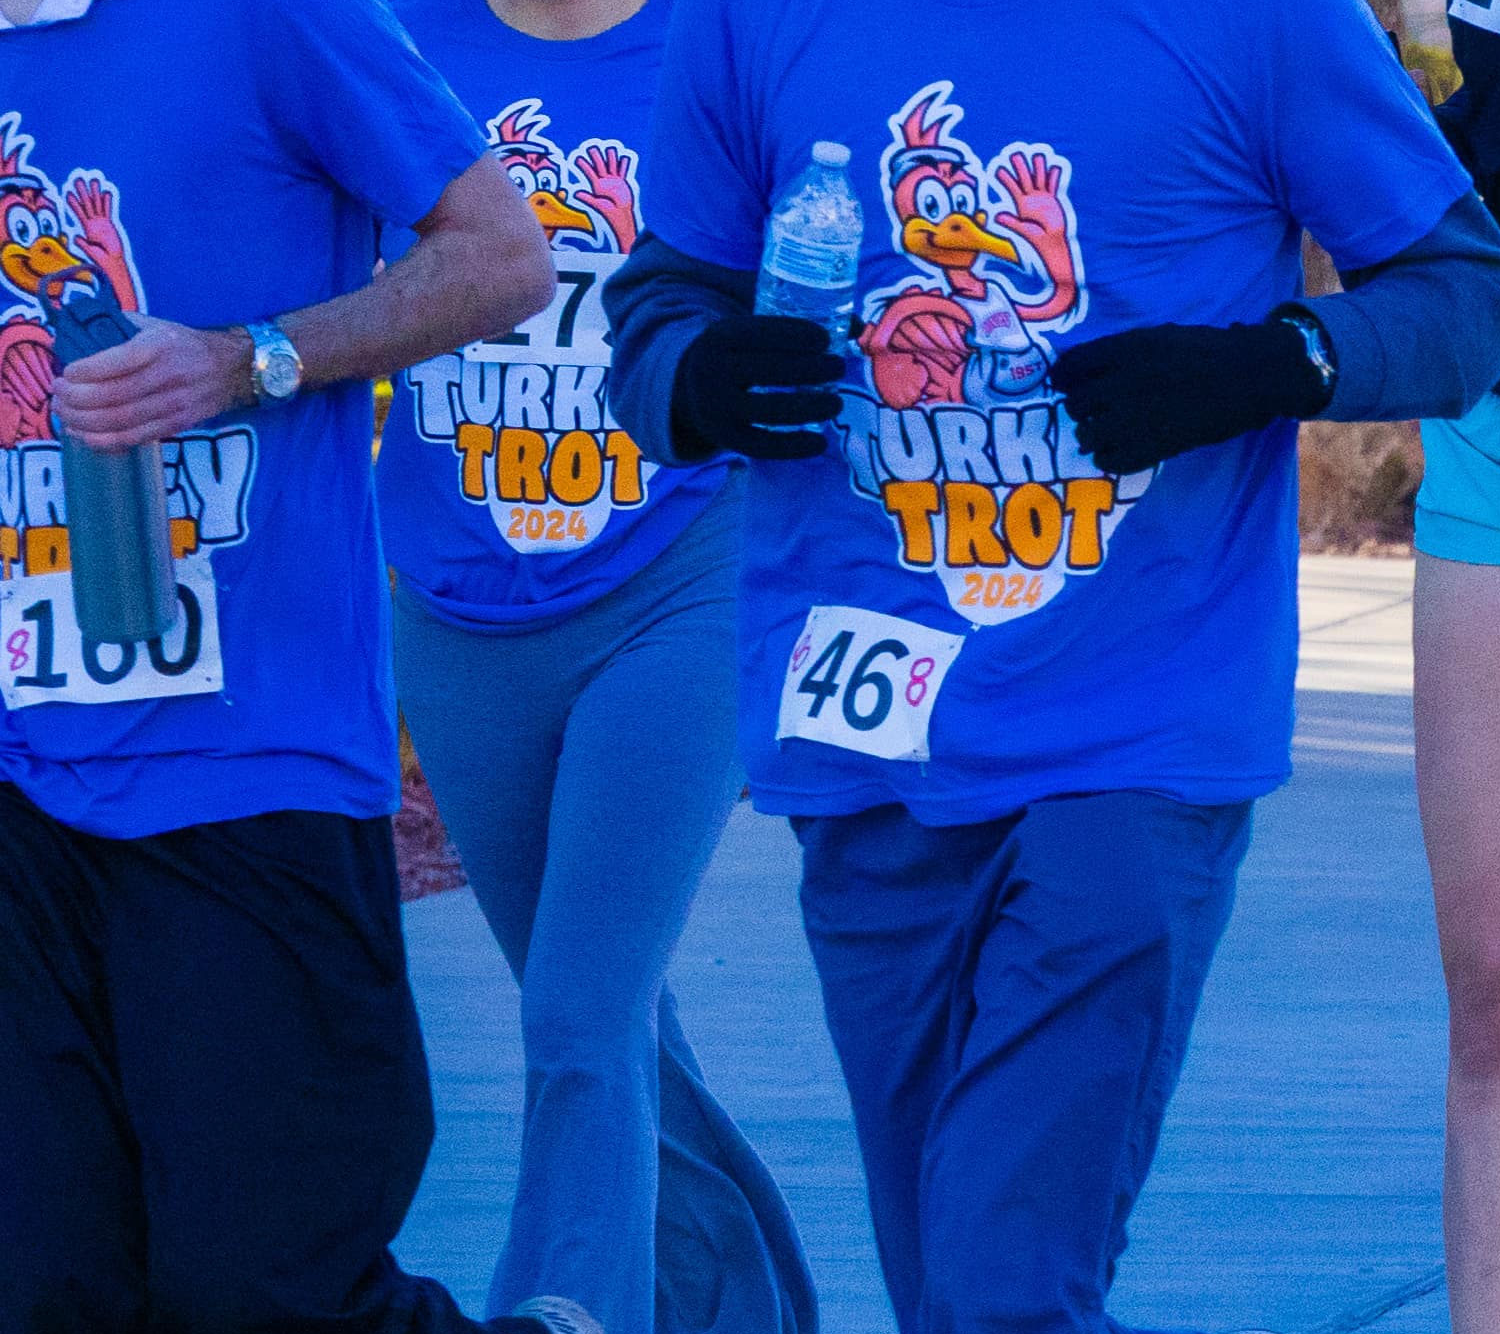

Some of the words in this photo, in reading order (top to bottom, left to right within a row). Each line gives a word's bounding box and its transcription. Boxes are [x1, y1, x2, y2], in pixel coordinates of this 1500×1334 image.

[404, 352, 624, 439] TURK
[456, 423, 645, 505] TROT
[506, 506, 589, 542] 2024
[881, 477, 1115, 570] TROT
[957, 572, 1044, 609] 2024
[796, 629, 911, 733] 46
[904, 656, 936, 708] 8
